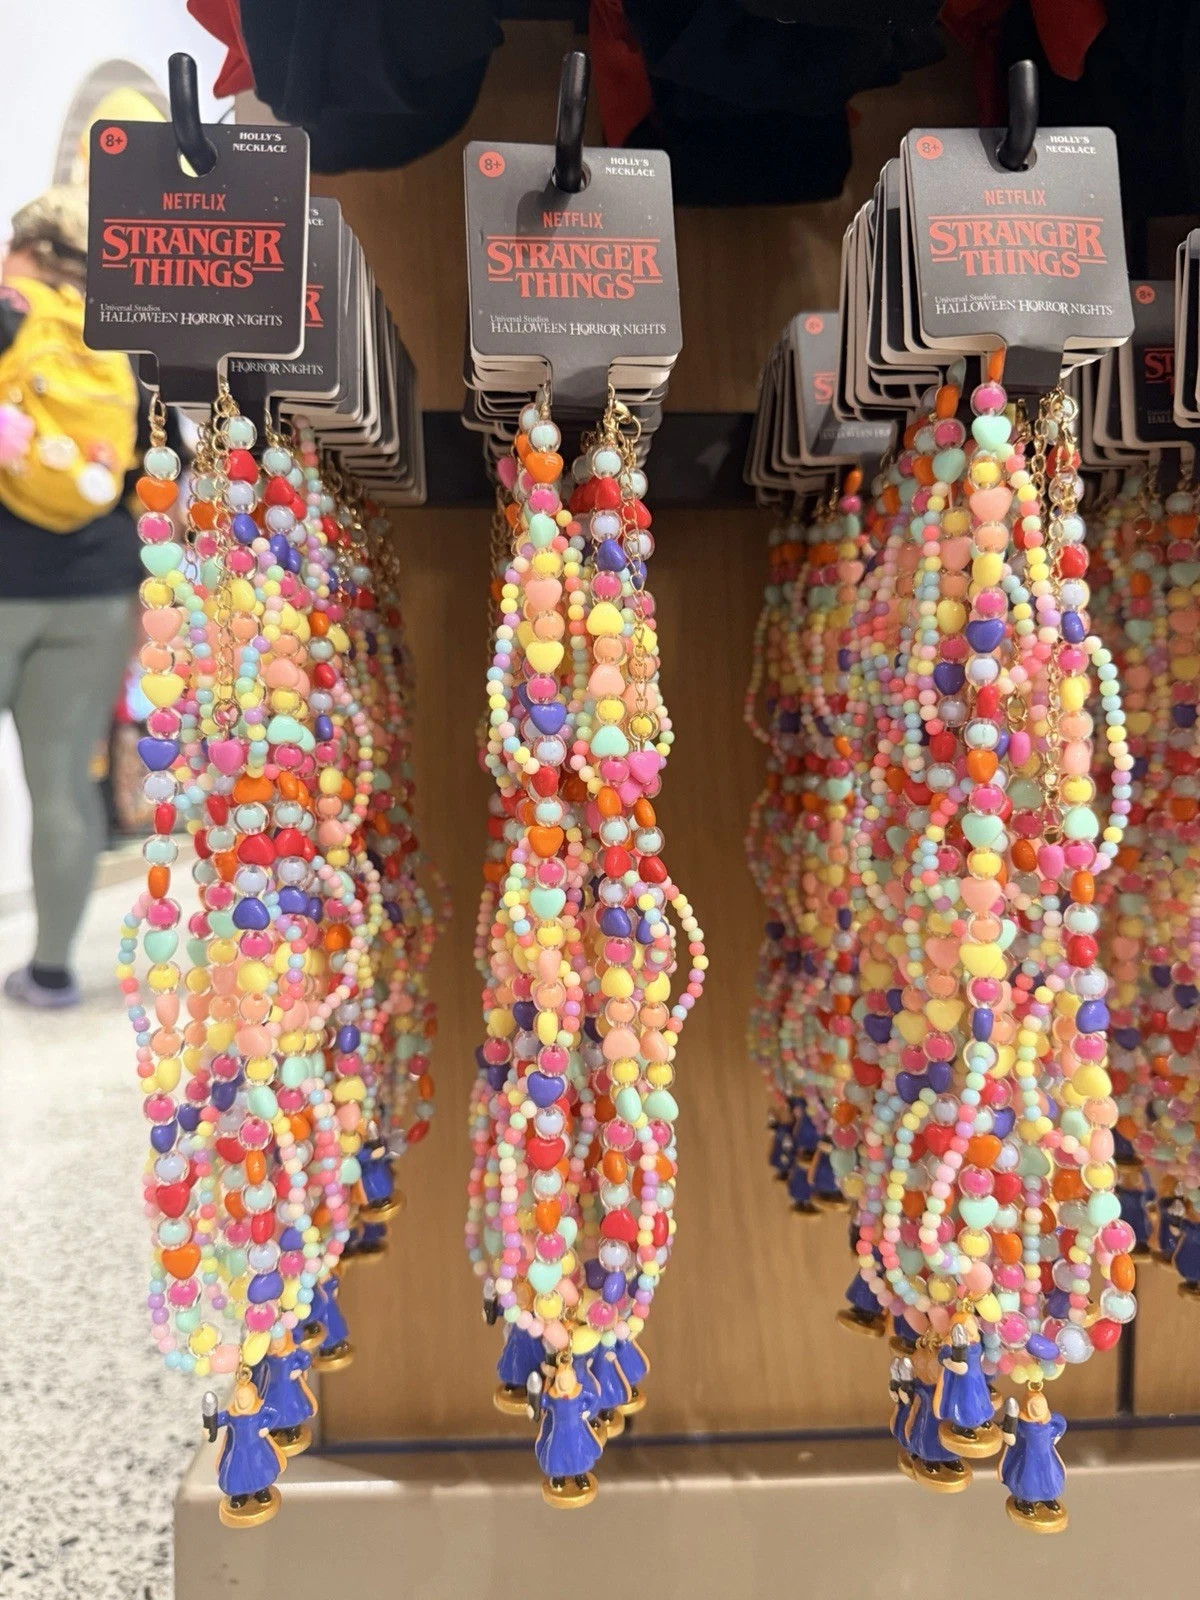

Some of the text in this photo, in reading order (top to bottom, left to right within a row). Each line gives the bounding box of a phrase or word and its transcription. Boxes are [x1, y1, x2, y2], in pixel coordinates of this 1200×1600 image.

[105, 135, 123, 147] 8+
[238, 130, 282, 142] HOLLY'S
[1050, 135, 1090, 144] HOLLY'S
[232, 142, 287, 153] NECKLACE
[922, 142, 939, 153] 8+
[1046, 144, 1096, 154] NECKLACE
[484, 159, 502, 171] 8+
[610, 156, 649, 166] HOLLY'S
[605, 166, 655, 177] NECKLACE
[162, 193, 226, 212] NETFLIX
[984, 189, 1047, 206] NETFLIX
[543, 212, 603, 229] NETFLIX
[102, 225, 284, 264] STRANGER
[929, 221, 1107, 257] STRANGER
[487, 241, 661, 276] STRANGER
[960, 250, 1081, 278] THINGS
[131, 259, 254, 287] THINGS
[516, 272, 635, 299] THINGS
[1139, 291, 1153, 299] 8+
[100, 303, 132, 312] Universal
[935, 299, 1113, 316] HALLOWEEN HORROR NIGHTS
[100, 310, 283, 326] HALLOWEEN HORROR NIGHTS
[490, 315, 522, 323] Universal
[491, 322, 666, 337] HALLOWEEN HORROR NIGHTS
[231, 360, 323, 375] HORROR NIGHTS
